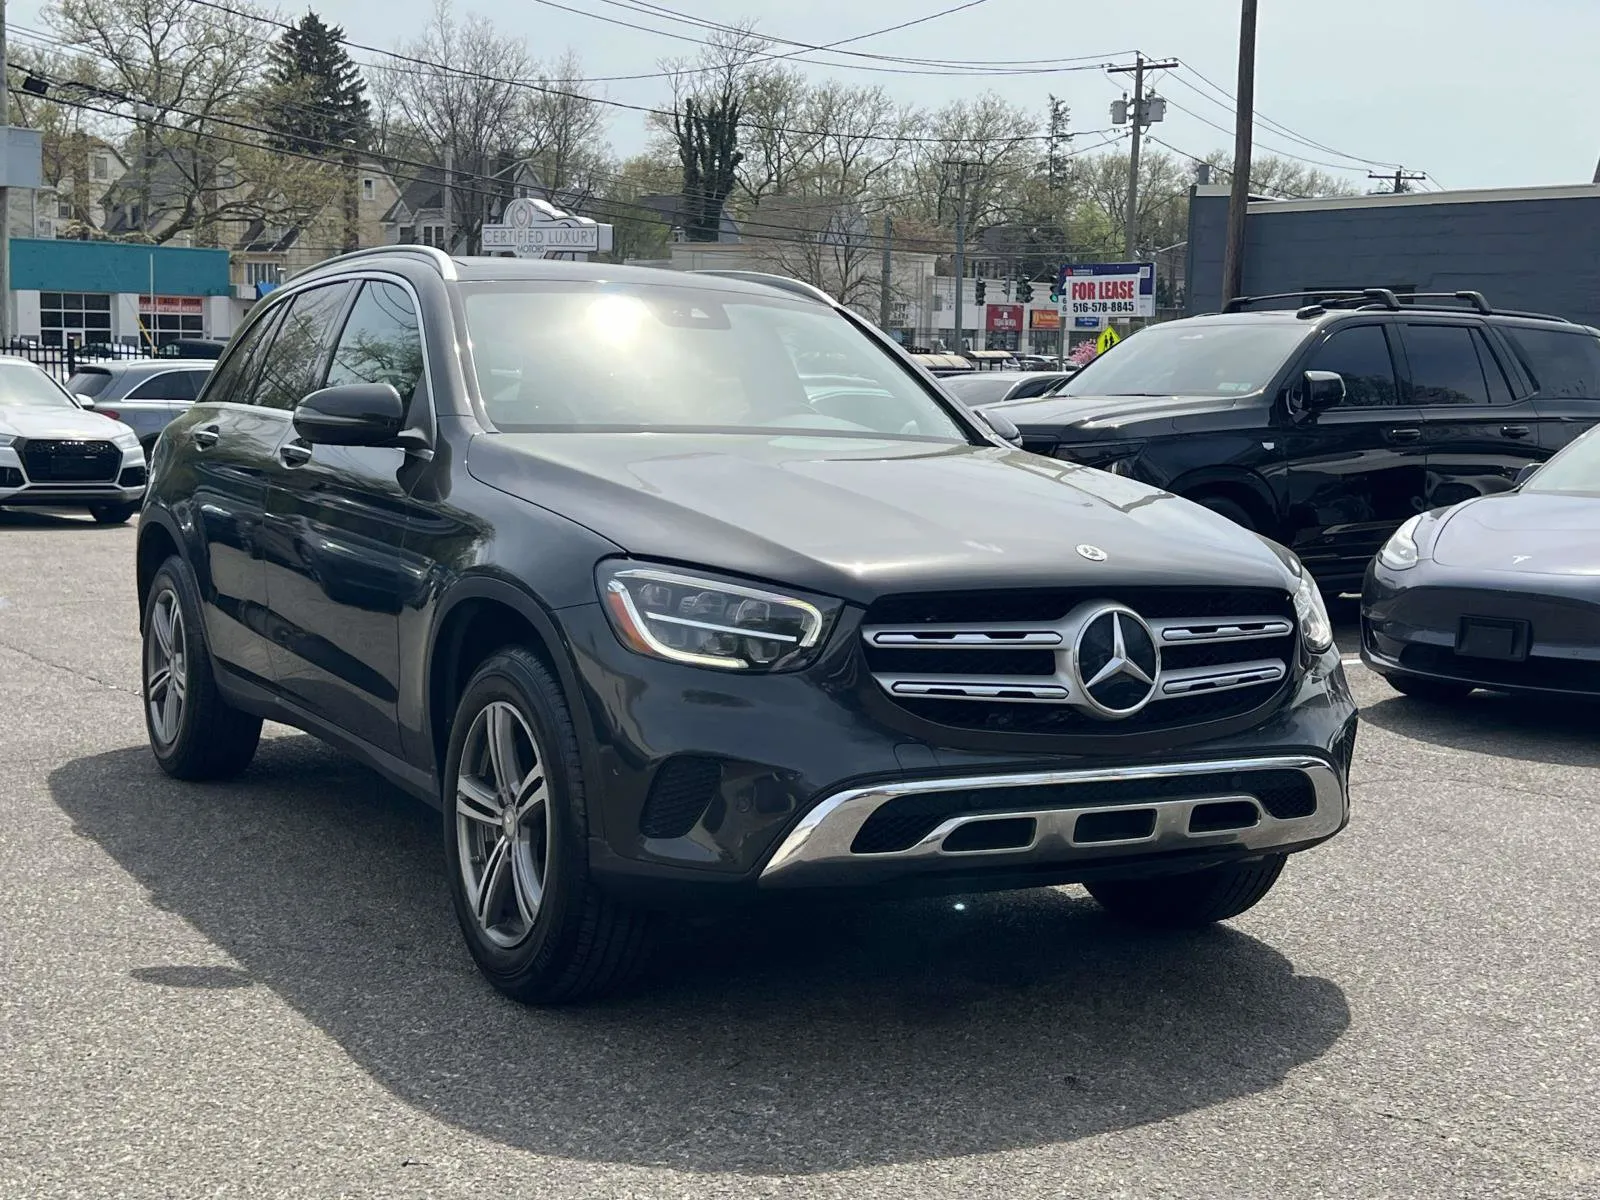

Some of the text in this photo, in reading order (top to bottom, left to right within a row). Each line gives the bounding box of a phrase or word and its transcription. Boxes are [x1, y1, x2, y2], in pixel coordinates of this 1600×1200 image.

[483, 230, 596, 245] CERTIFIED LUXURY
[517, 244, 546, 254] MOTORS
[1072, 281, 1134, 300] FOR LEASE
[1073, 301, 1134, 313] 516-578-8845
